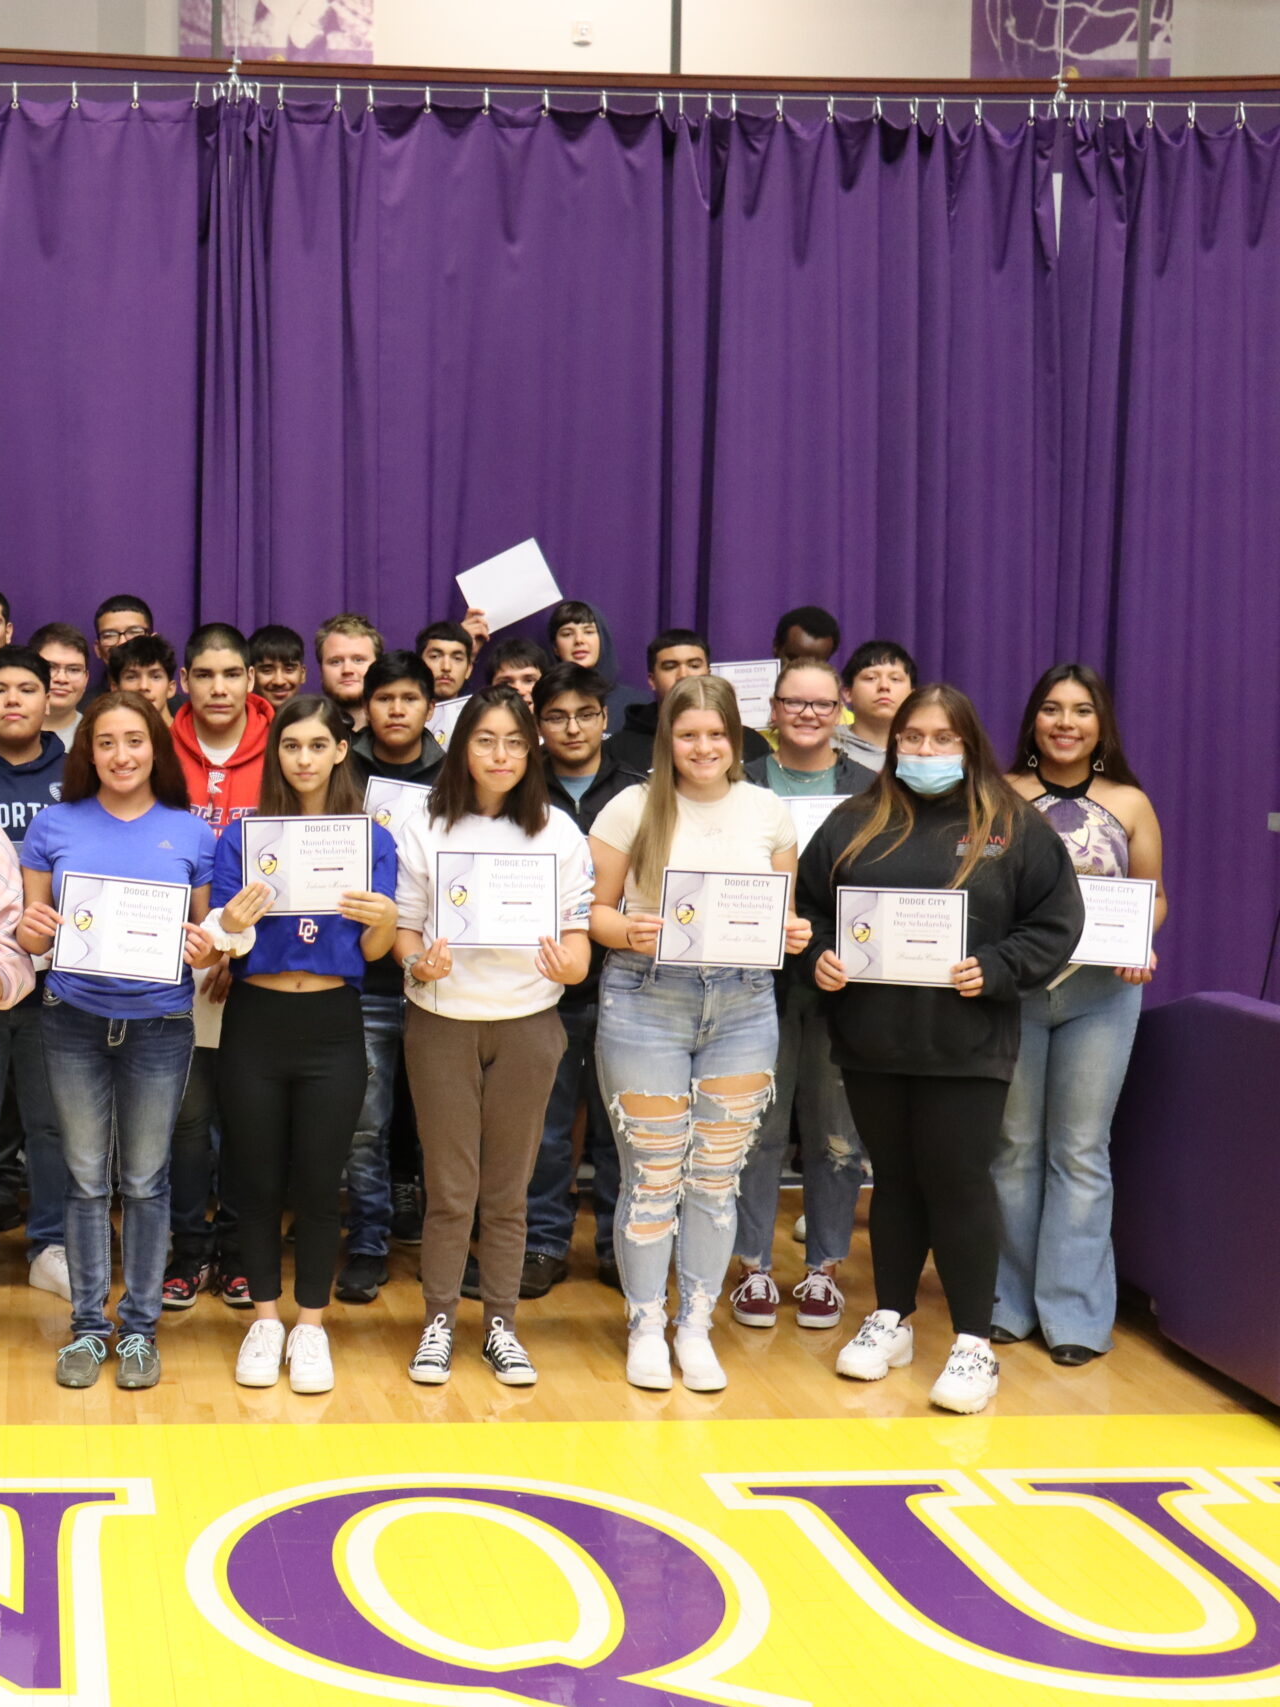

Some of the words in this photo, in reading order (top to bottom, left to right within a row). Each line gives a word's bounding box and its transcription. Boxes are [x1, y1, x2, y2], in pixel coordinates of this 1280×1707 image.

[304, 824, 331, 833] DODGE
[333, 824, 352, 832] CITY
[494, 858, 519, 867] DODGE
[521, 858, 539, 867] CITY
[725, 878, 750, 887] DODGE
[752, 879, 771, 888] CITY
[123, 886, 149, 897] DODGE
[152, 888, 171, 899] CITY
[899, 897, 925, 905] DODGE
[928, 897, 947, 906] CITY
